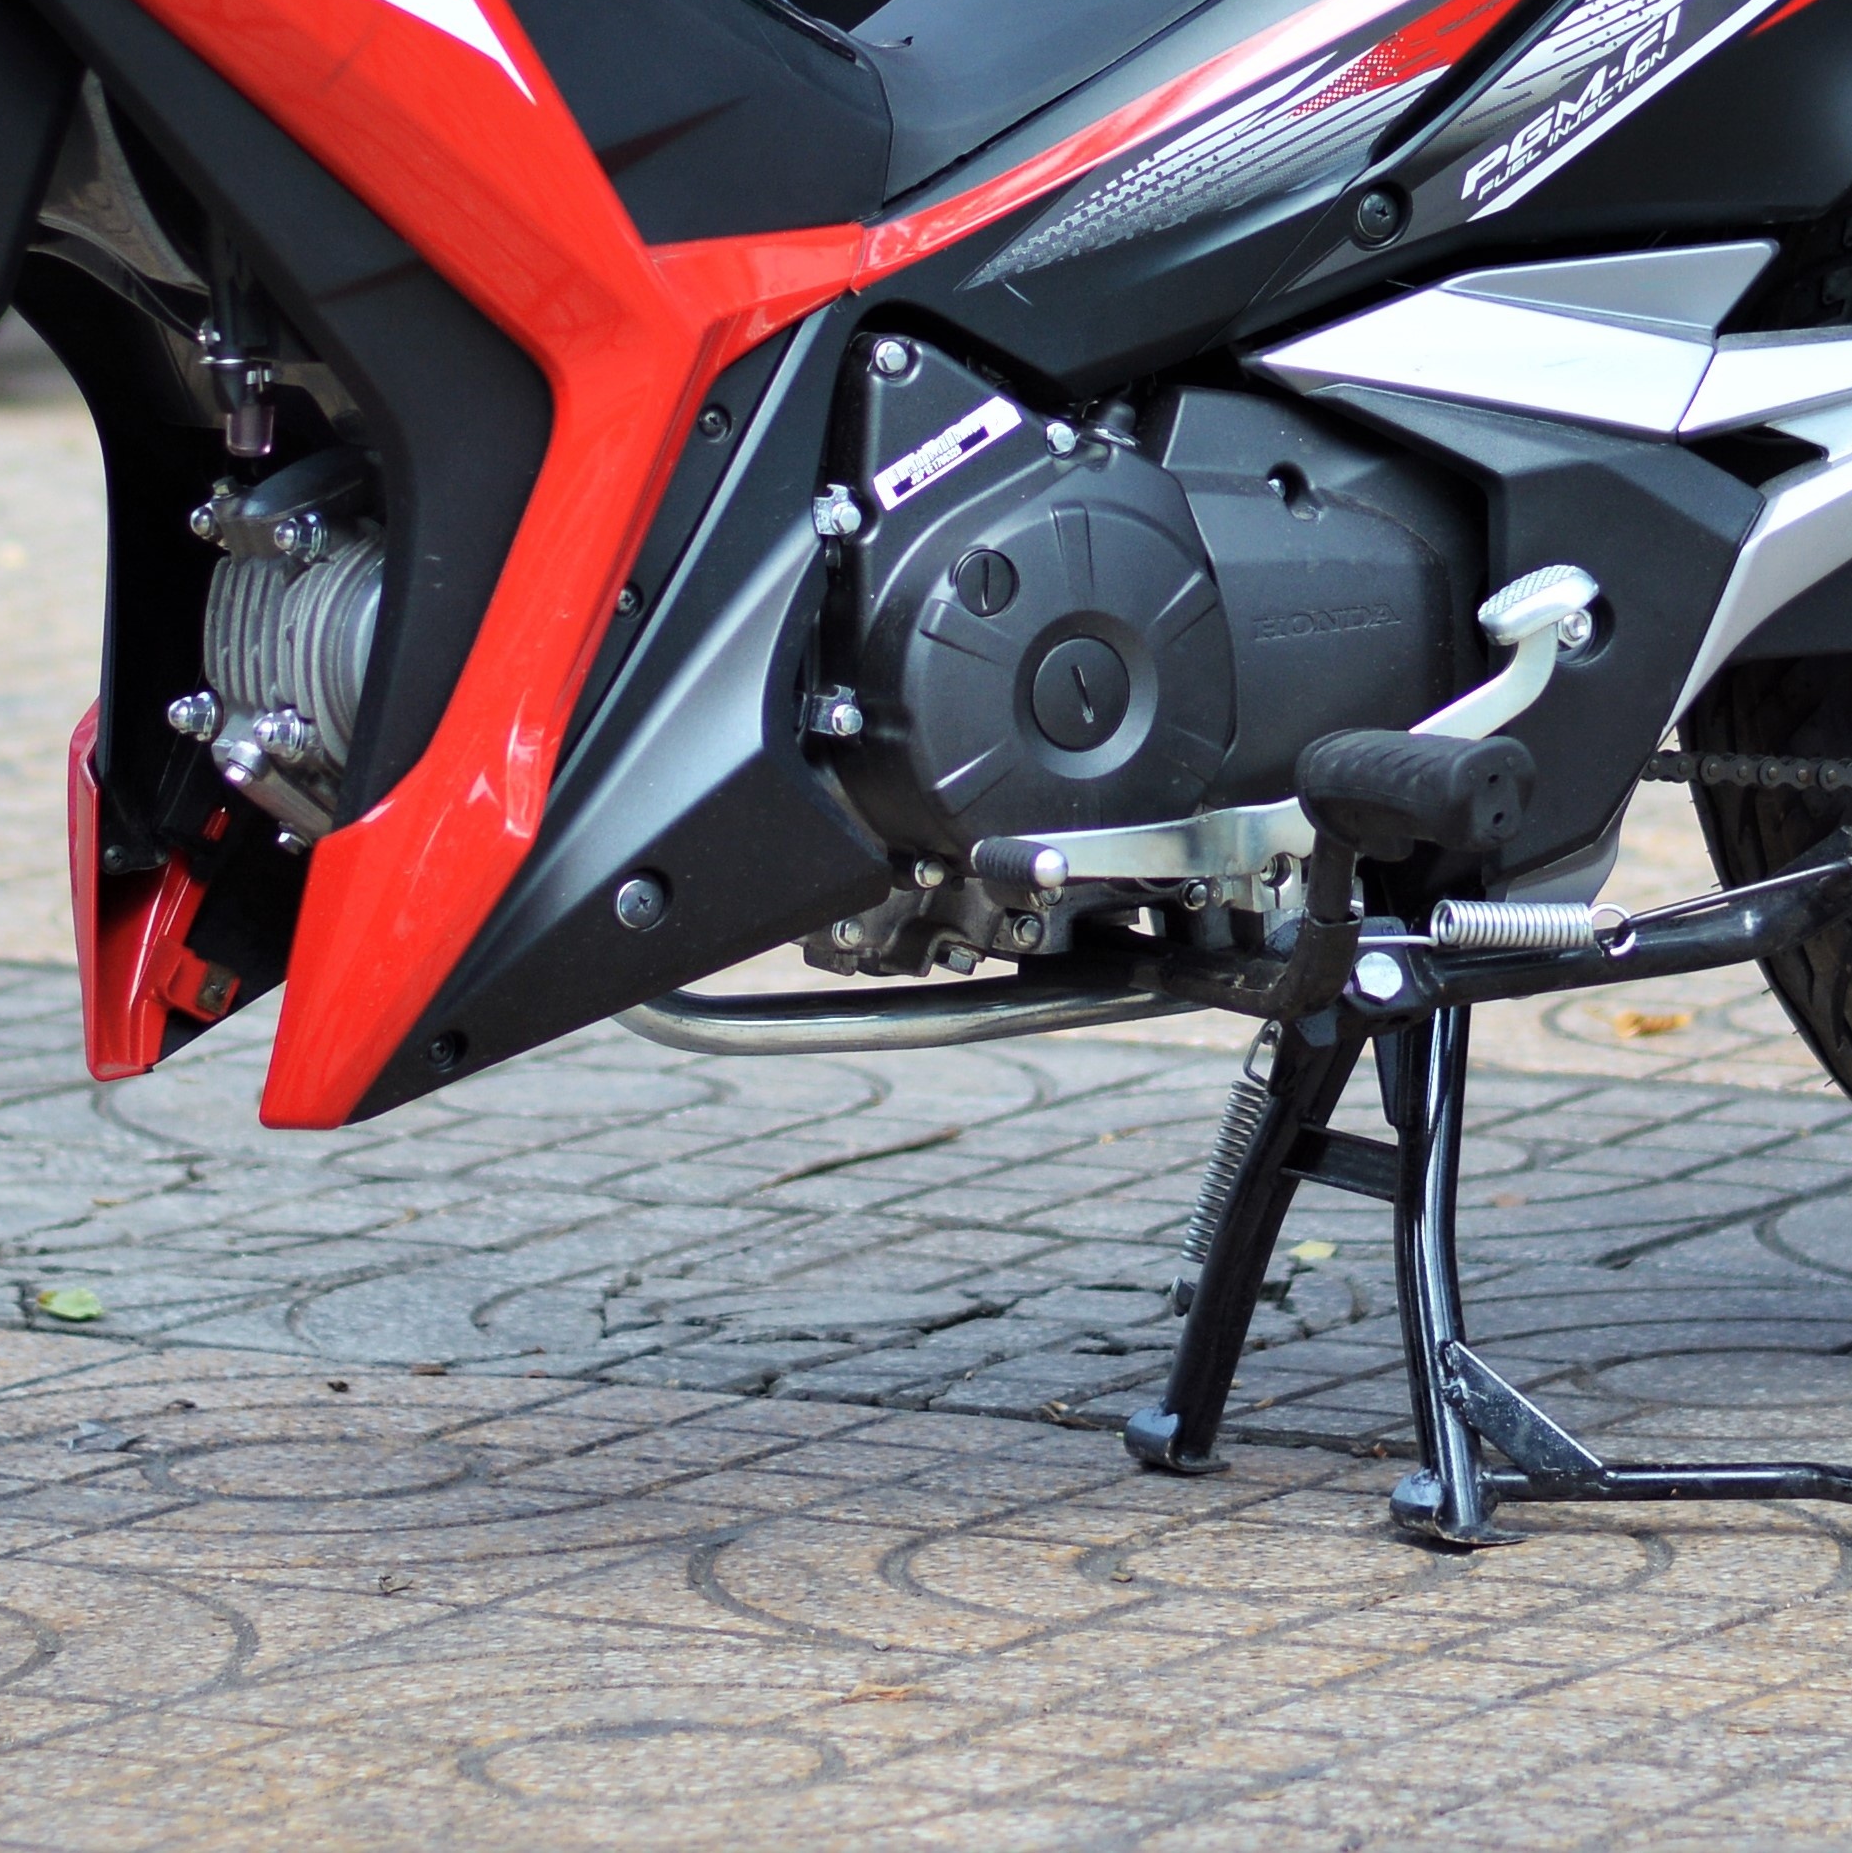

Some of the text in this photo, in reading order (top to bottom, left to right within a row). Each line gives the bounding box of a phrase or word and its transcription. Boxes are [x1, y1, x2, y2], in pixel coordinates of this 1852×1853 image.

[1477, 43, 1669, 202] FUEL INJECTION
[1252, 603, 1401, 641] HONDA
